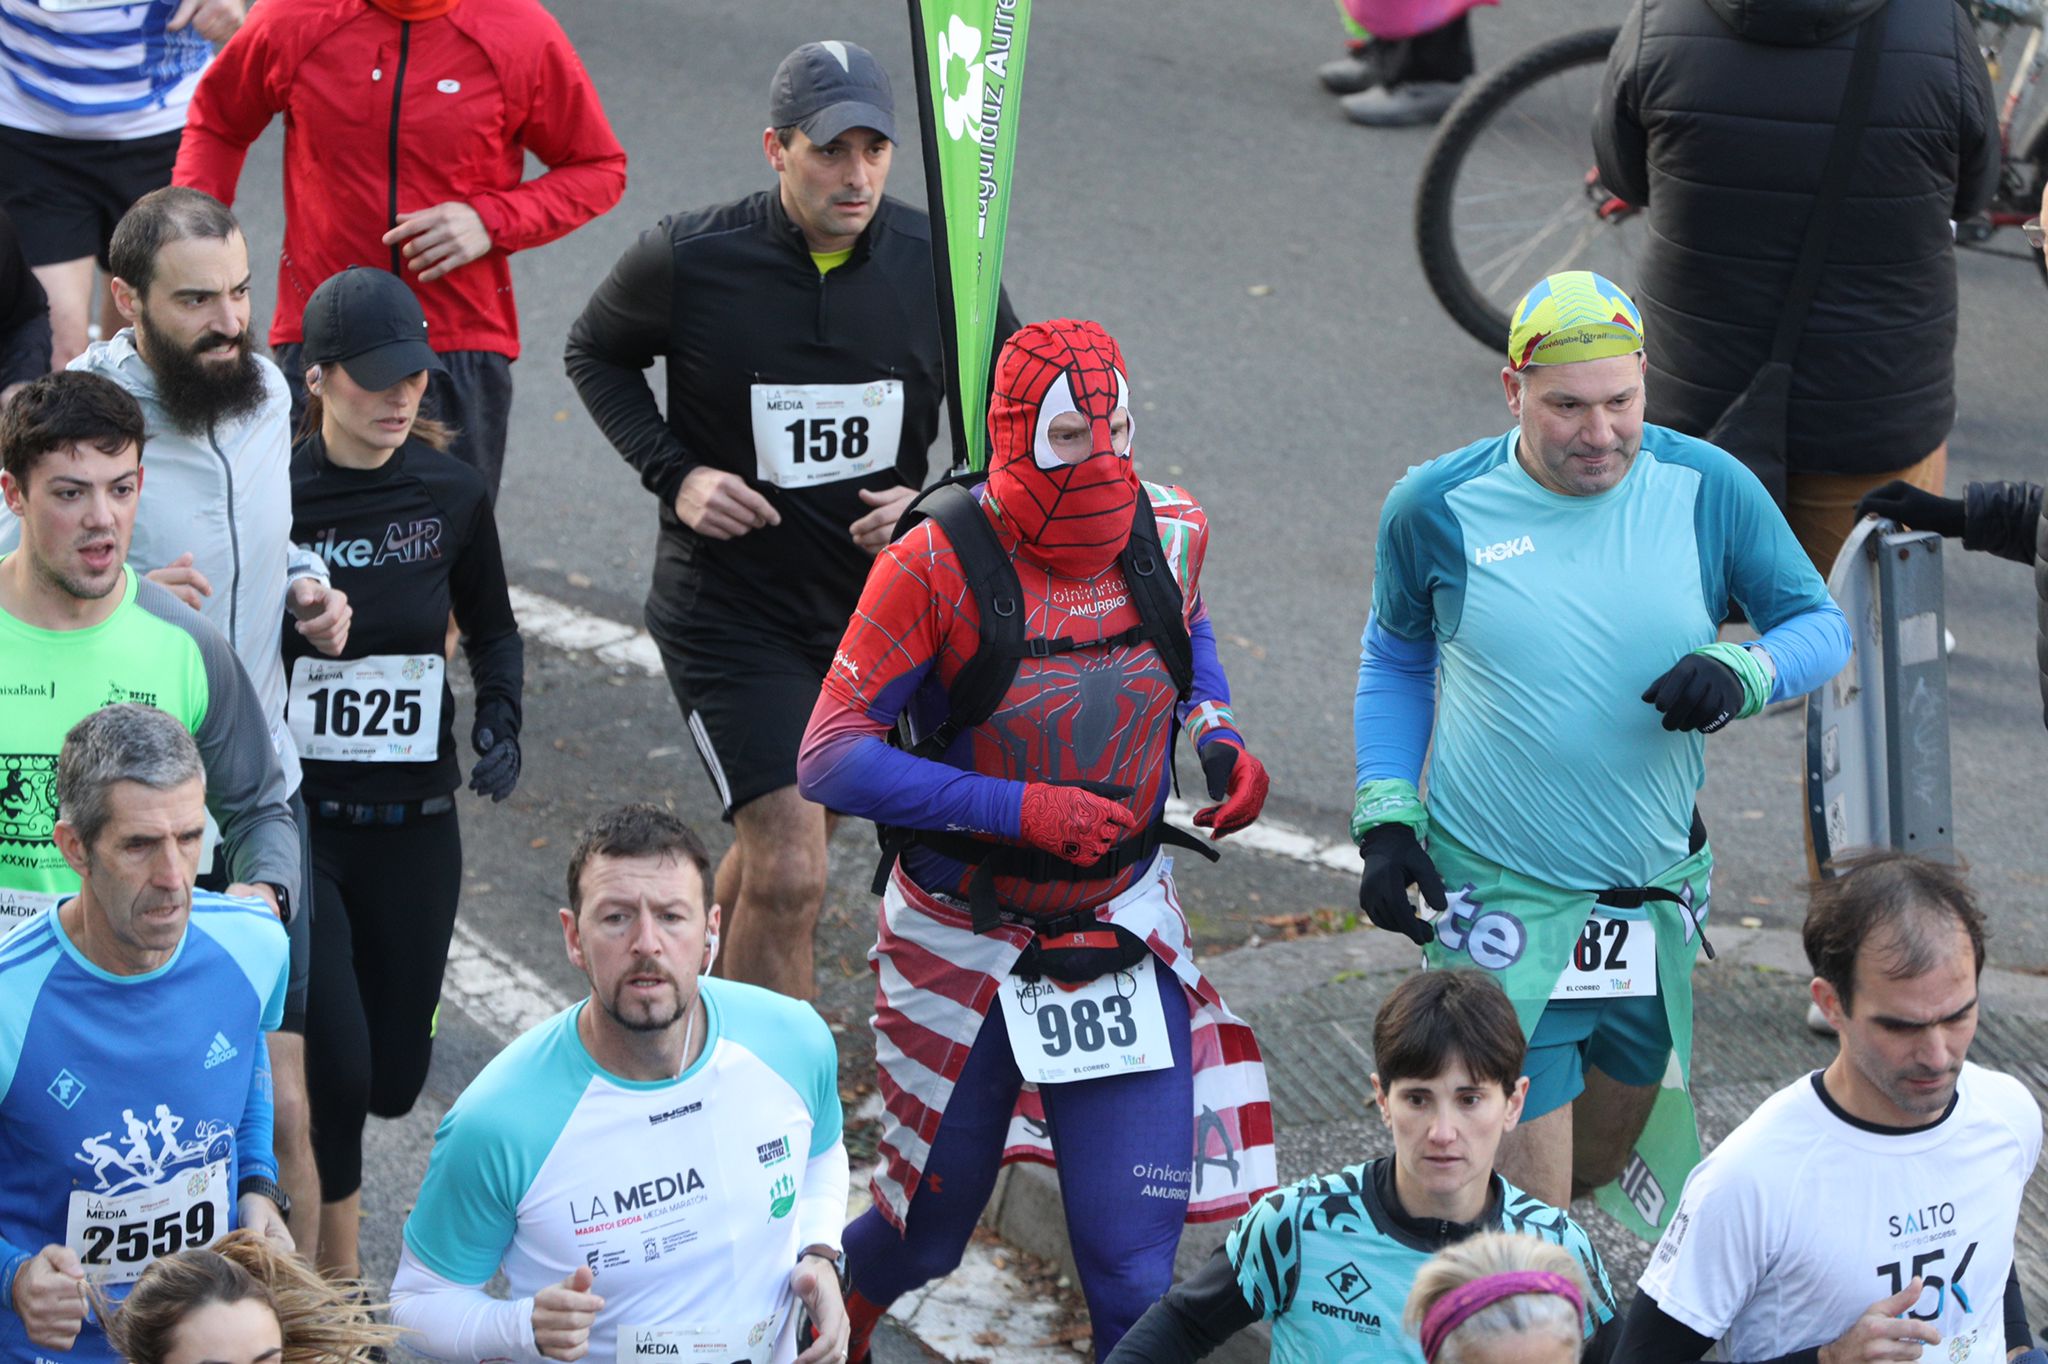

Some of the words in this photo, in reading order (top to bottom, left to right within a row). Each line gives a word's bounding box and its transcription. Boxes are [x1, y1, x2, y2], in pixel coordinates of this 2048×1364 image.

[767, 401, 804, 410] MEDIA
[785, 416, 869, 463] 158
[298, 528, 373, 567] ike
[373, 518, 442, 566] AIR
[1475, 535, 1536, 566] HOKA
[1069, 595, 1127, 617] AMURRIO
[308, 671, 343, 682] MEDIA
[307, 688, 421, 737] 1625
[1, 854, 39, 869] XXXIV
[0, 905, 37, 917] MEDIA
[1016, 984, 1055, 1000] MEDIA
[1575, 984, 1600, 992] CORREO
[1610, 978, 1632, 990] Vital
[1037, 995, 1138, 1057] 983
[204, 1046, 238, 1069] adidas
[1120, 1053, 1146, 1065] Vital
[1083, 1063, 1110, 1072] CORREO
[757, 1138, 783, 1154] VITORIA
[570, 1196, 608, 1224] LA
[613, 1168, 705, 1214] MEDIA
[1141, 1184, 1189, 1200] AMURRIO
[87, 1197, 103, 1210] LA
[86, 1209, 127, 1220] MEDIA
[575, 1221, 615, 1236] MARATOI
[617, 1215, 642, 1228] ERDIA
[644, 1206, 668, 1219] MEDIA
[1888, 1202, 1955, 1238] SALTO
[81, 1201, 215, 1265] 2559
[1340, 1272, 1358, 1293] F
[1312, 1300, 1382, 1327] FORTUNA
[636, 1332, 652, 1343] LA
[636, 1344, 679, 1355] MEDIA
